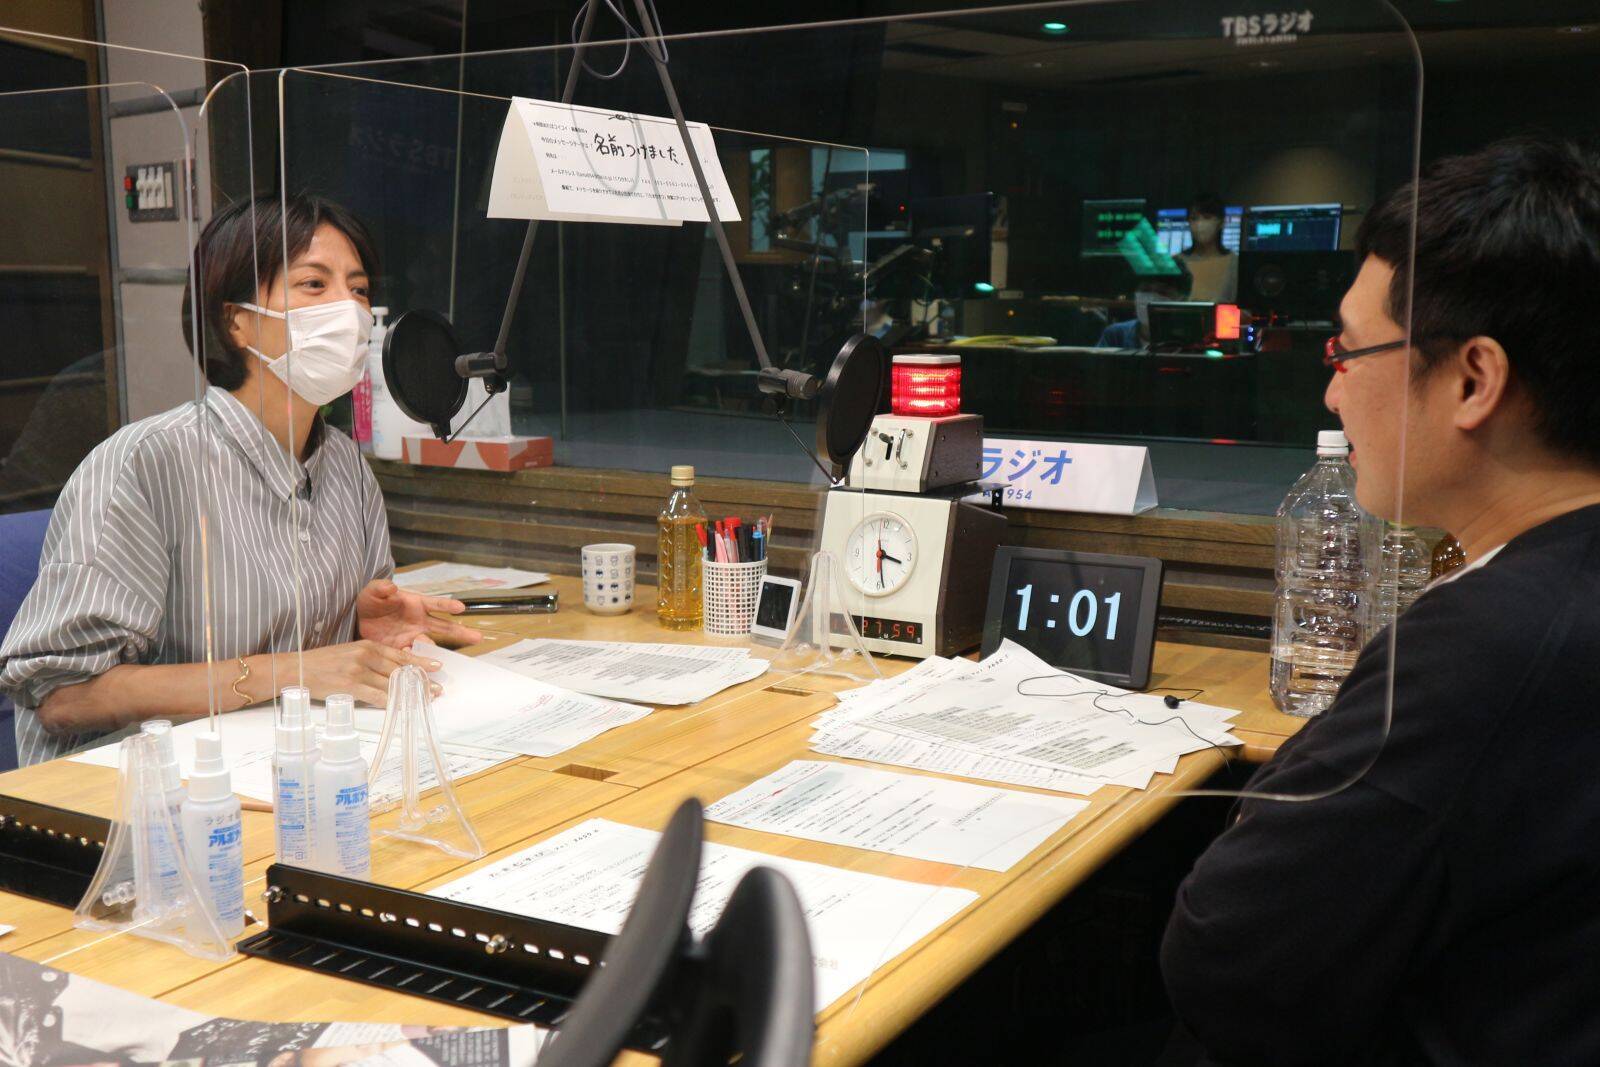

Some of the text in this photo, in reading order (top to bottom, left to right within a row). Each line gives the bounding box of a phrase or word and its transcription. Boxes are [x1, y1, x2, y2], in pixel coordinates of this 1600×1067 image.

[1221, 9, 1314, 37] TBSラジオ
[983, 448, 1072, 485] ラジオ
[1007, 489, 1033, 500] 954
[883, 519, 890, 529] 12
[907, 552, 912, 561] 3
[876, 581, 881, 590] 6
[1016, 584, 1121, 641] 1:01
